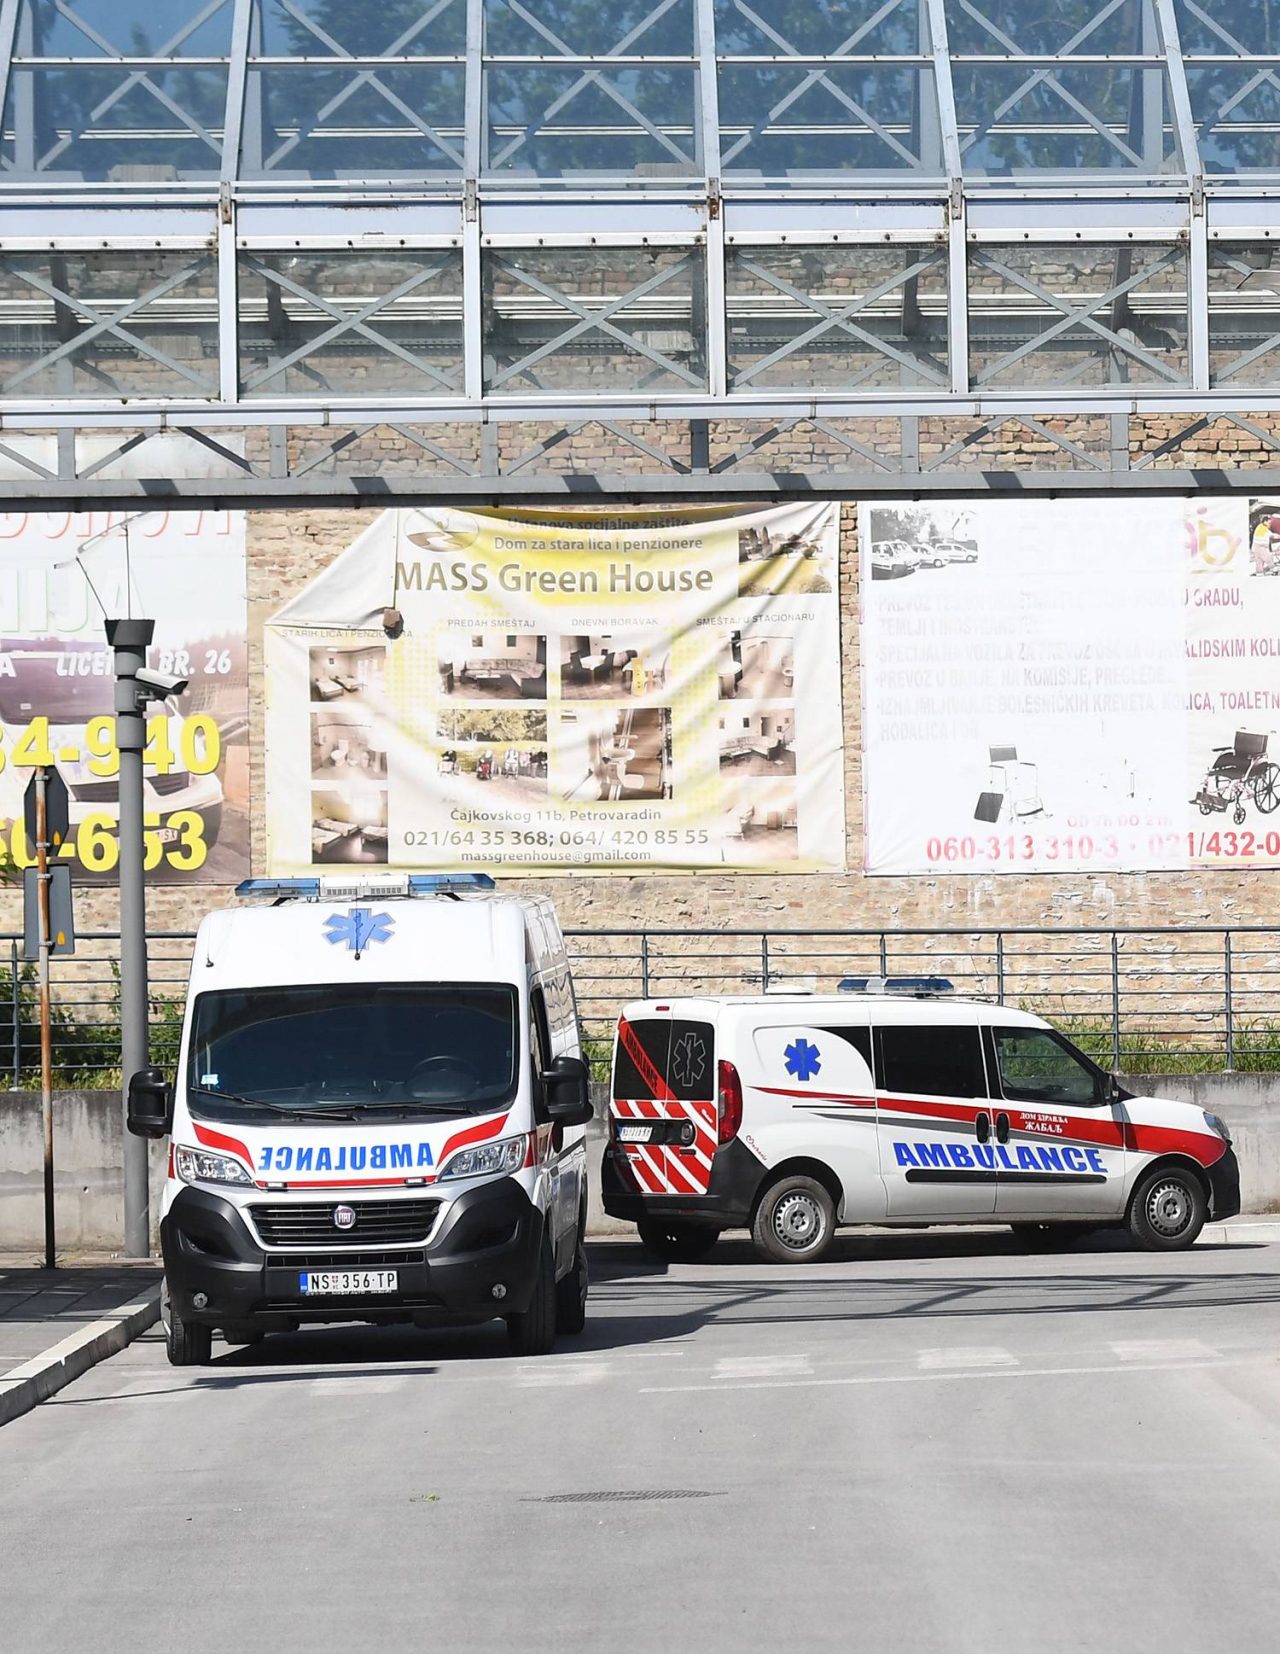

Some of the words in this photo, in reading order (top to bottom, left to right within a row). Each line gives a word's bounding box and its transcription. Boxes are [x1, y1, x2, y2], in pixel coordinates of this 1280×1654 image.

[494, 537, 529, 551] Dom
[531, 540, 547, 551] za
[549, 538, 586, 551] stara
[588, 537, 613, 551] lica
[616, 537, 621, 551] i
[623, 537, 704, 554] penzionere
[396, 562, 488, 593] MASS
[497, 563, 599, 593] Green
[608, 564, 714, 593] House
[447, 618, 487, 628] PREDAH
[491, 617, 536, 628] SMEŠTAJ
[571, 618, 609, 627] DNEVNI
[203, 650, 232, 675] 26
[450, 808, 531, 823] Čajkovskog
[536, 810, 566, 823] 11b,
[569, 808, 662, 822] Petrovaradin
[404, 830, 476, 847] 021/64
[480, 830, 506, 845] 35
[511, 830, 555, 847] 368;
[559, 830, 605, 847] 064/
[611, 829, 648, 845] 420
[654, 829, 678, 844] 85
[684, 828, 710, 844] 55
[460, 850, 652, 864] massgreenhouse@gmail.com
[1019, 1112, 1036, 1121] ДОМ
[1024, 1121, 1063, 1134] ЖАБАЉ
[892, 1142, 1108, 1173] AMBULANCE
[338, 1212, 352, 1224] FIAT
[311, 1274, 330, 1291] NS
